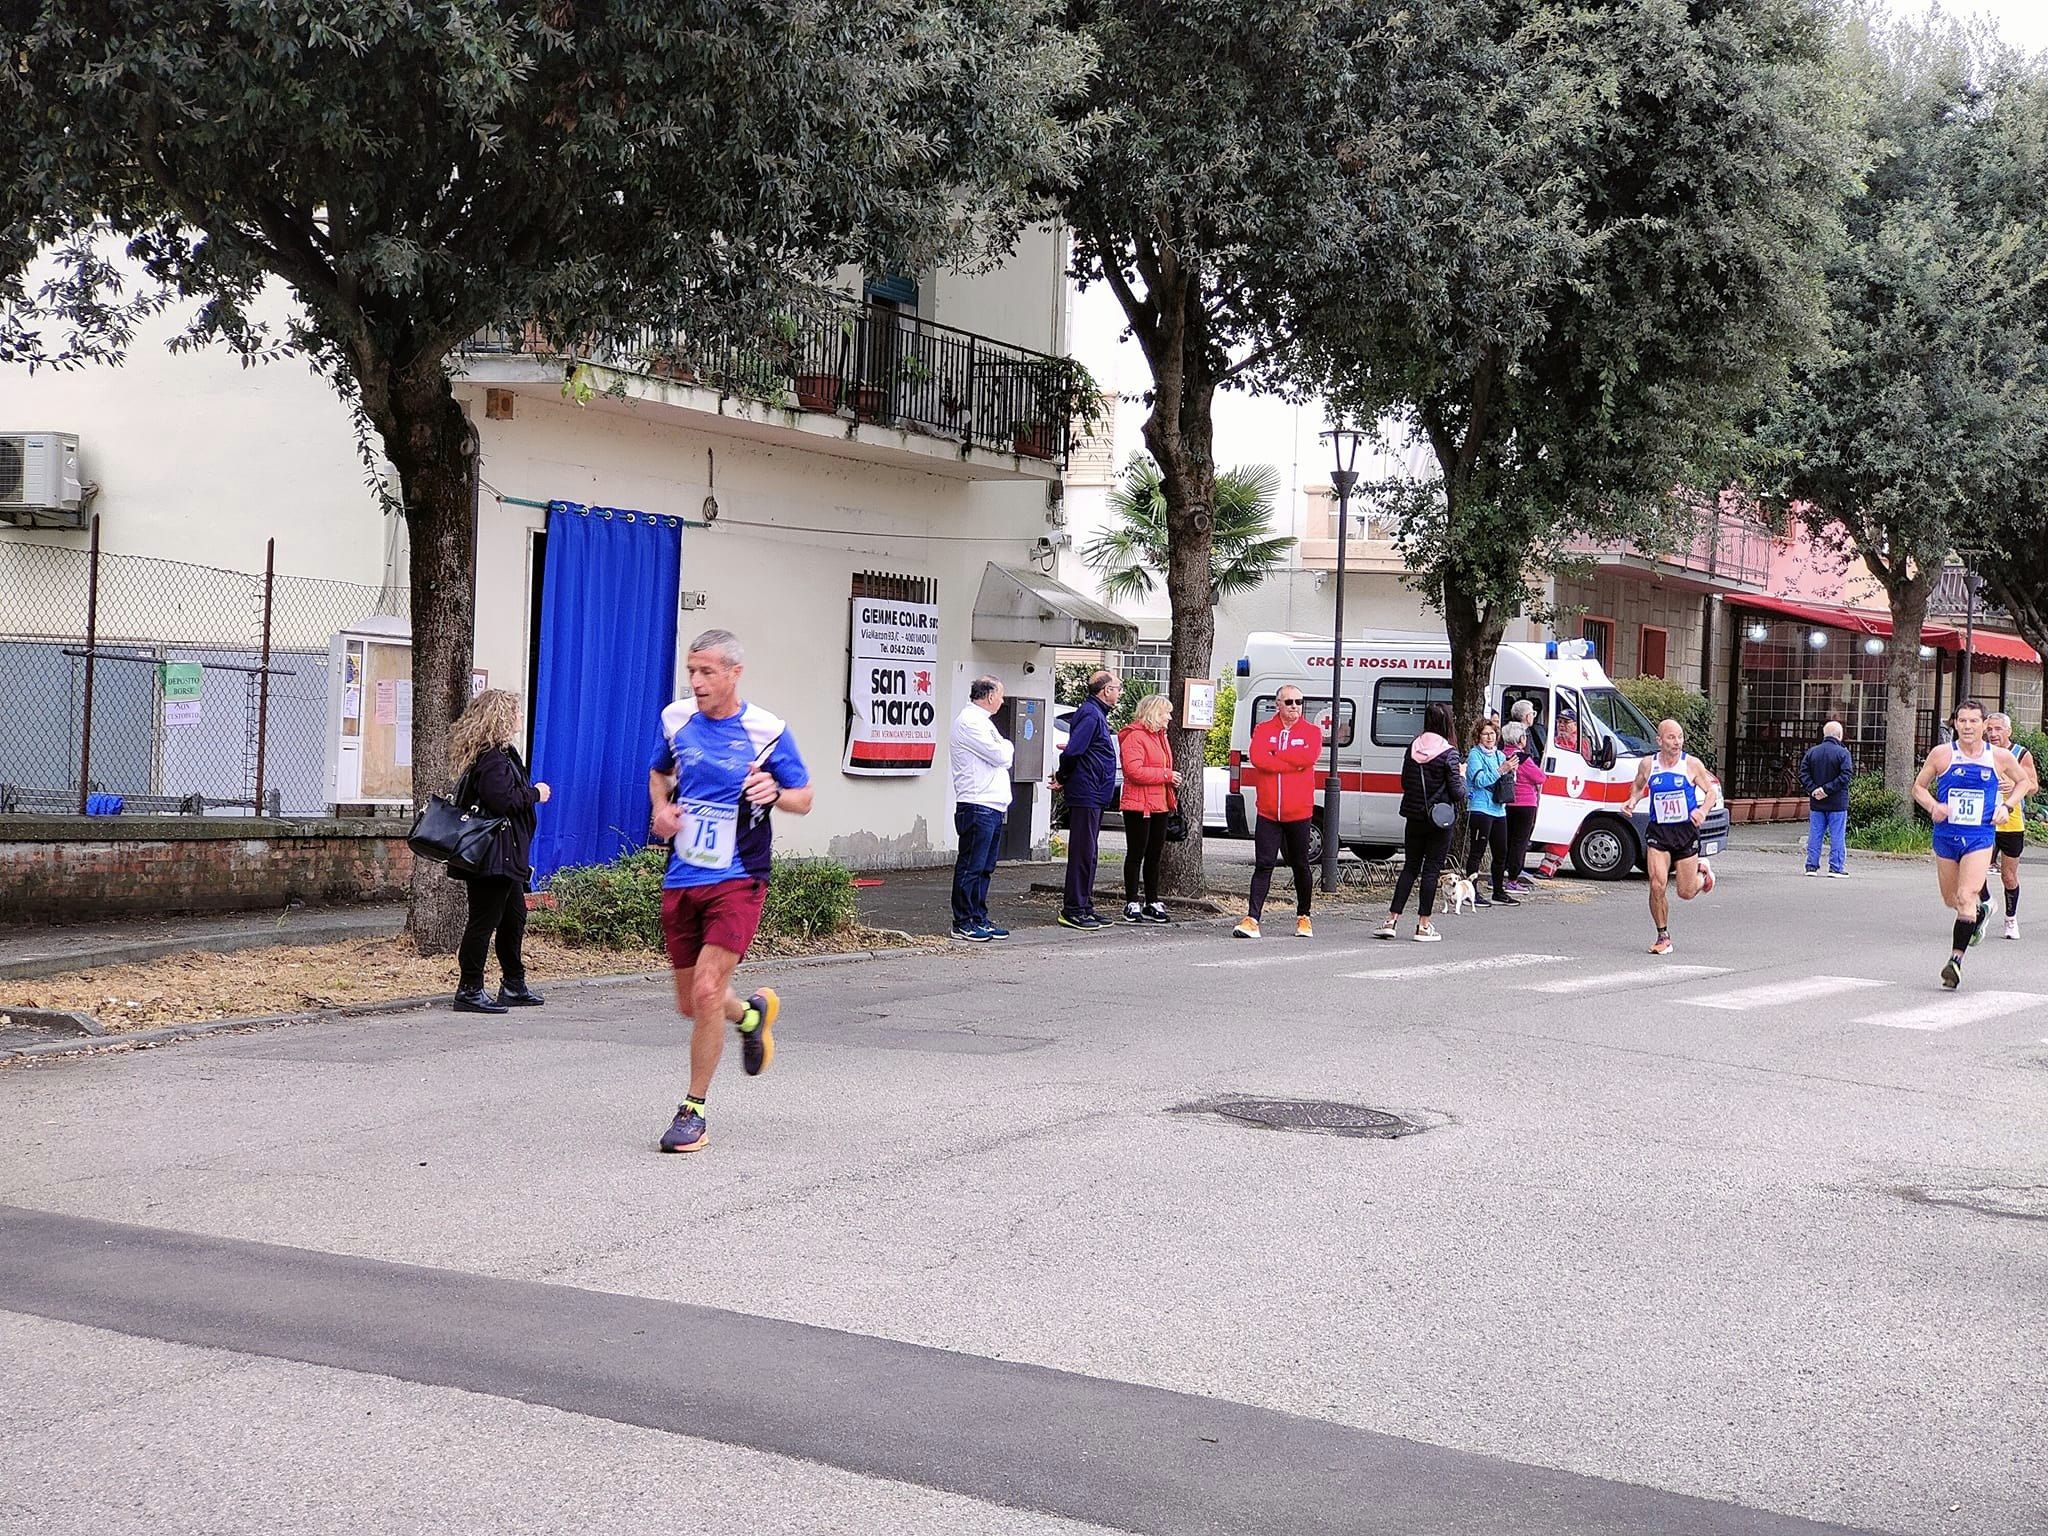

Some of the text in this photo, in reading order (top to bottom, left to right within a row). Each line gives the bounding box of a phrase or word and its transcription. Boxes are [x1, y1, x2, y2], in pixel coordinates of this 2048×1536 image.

[1307, 656, 1452, 670] CROCE ROSSA ITALI
[168, 677, 200, 685] DEPOSITO
[871, 668, 906, 695] san
[173, 687, 195, 695] BORSE
[871, 699, 935, 726] marco
[1662, 800, 1681, 815] 241
[1959, 799, 1974, 815] 35
[694, 819, 718, 849] 75
